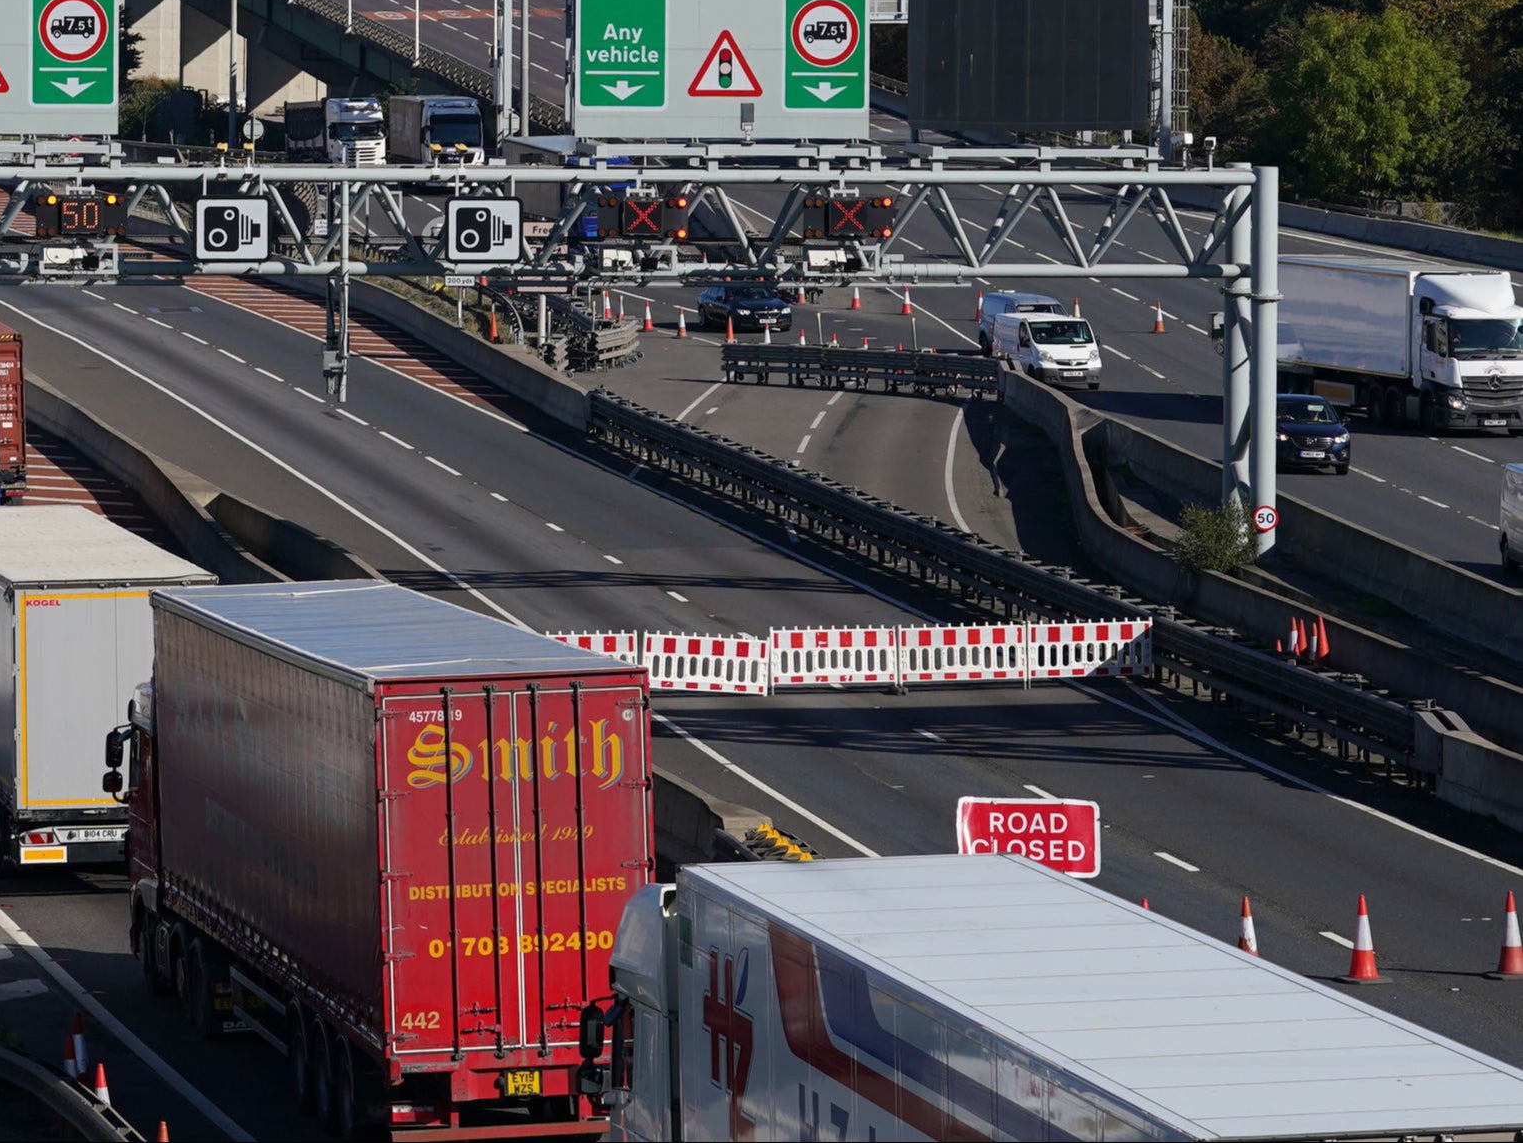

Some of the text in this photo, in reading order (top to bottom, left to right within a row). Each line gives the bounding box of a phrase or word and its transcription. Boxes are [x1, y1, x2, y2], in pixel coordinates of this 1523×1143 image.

[603, 23, 643, 44] Any
[586, 45, 660, 63] vehicle
[62, 201, 99, 229] 50
[446, 277, 473, 286] 200 yds
[1257, 513, 1275, 524] 50
[407, 718, 624, 790] Smith
[989, 811, 1068, 834] ROAD
[438, 823, 544, 846] Estabished
[525, 876, 626, 896] SECIALISTS
[401, 1011, 440, 1030] 442
[512, 1073, 534, 1083] EY19
